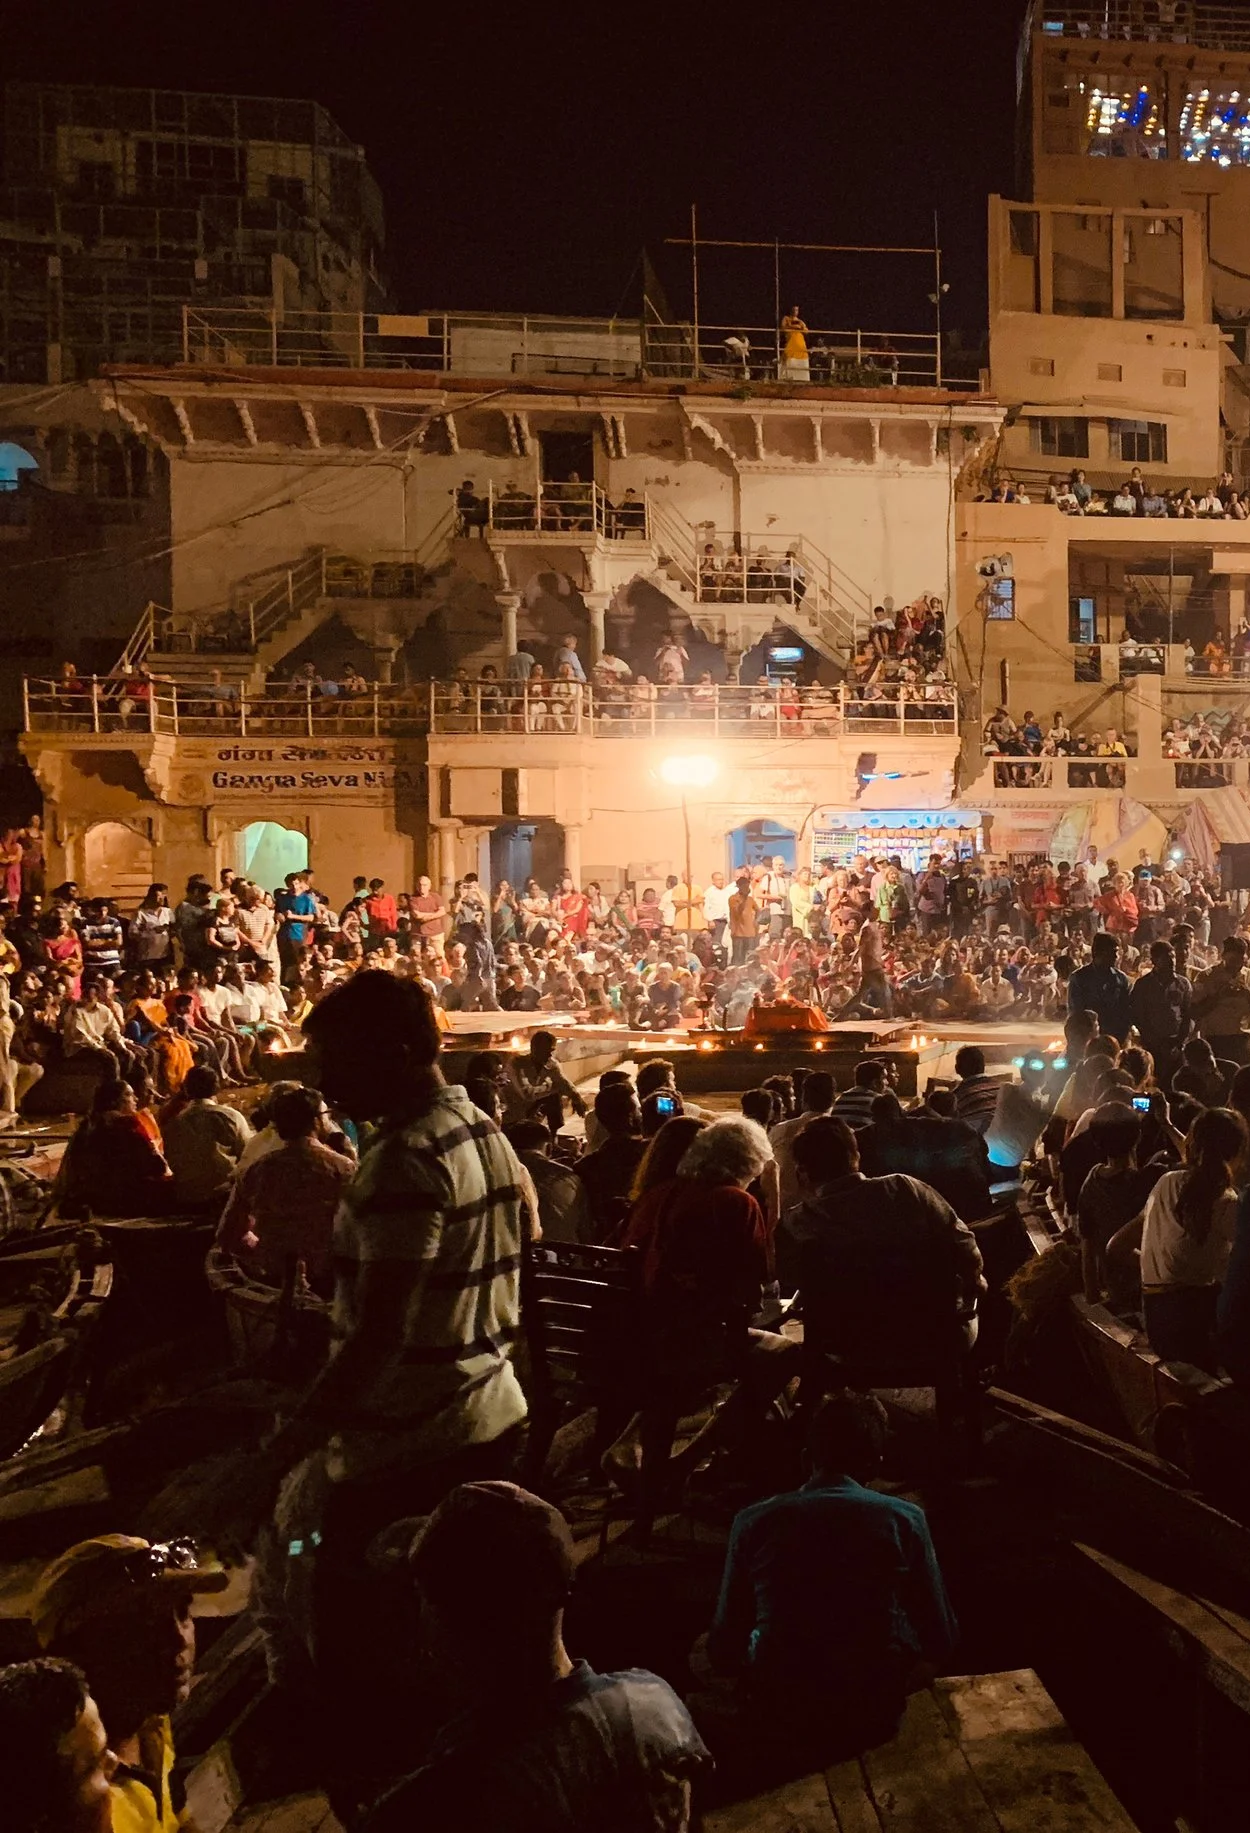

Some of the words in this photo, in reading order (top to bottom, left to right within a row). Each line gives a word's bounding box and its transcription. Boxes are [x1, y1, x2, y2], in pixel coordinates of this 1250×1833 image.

[217, 745, 274, 761] गंगा
[212, 771, 297, 793] Ganga
[300, 771, 358, 789] Seva
